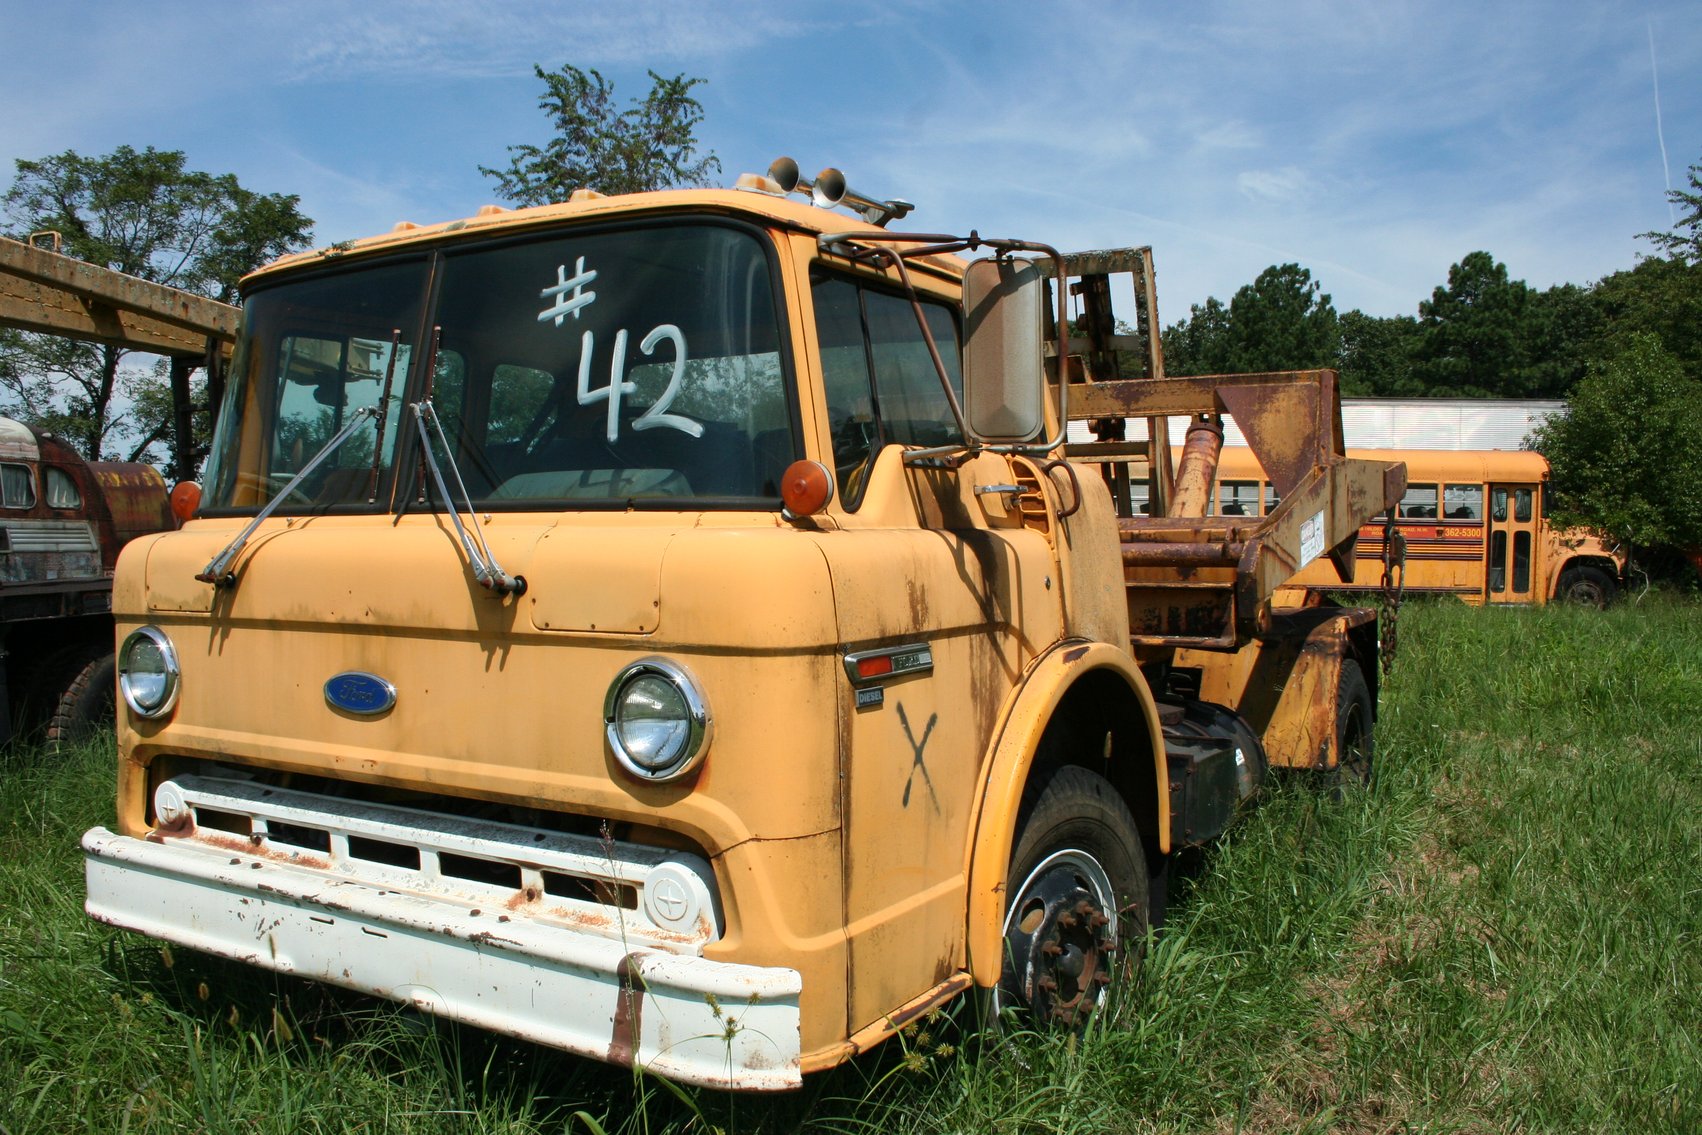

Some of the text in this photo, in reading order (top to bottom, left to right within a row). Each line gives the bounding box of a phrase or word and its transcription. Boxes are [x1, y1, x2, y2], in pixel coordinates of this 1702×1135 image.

[576, 323, 706, 445] 42
[1444, 527, 1482, 537] 362-5300
[859, 690, 882, 703] DIESEL
